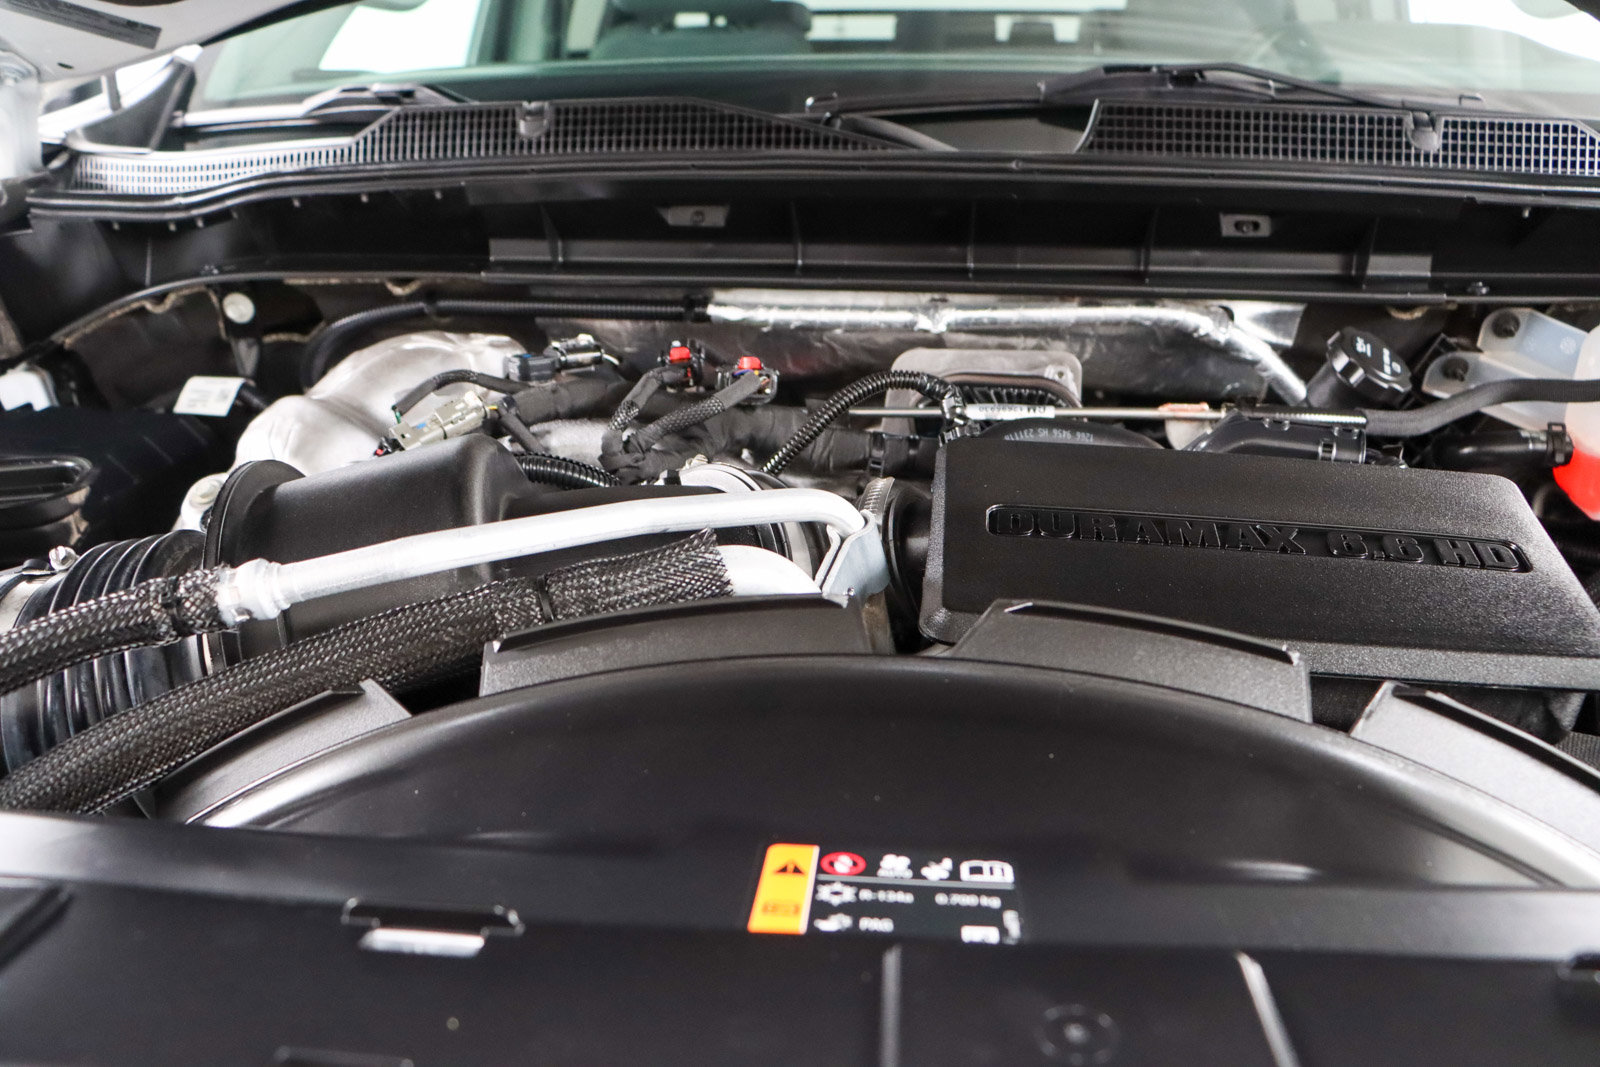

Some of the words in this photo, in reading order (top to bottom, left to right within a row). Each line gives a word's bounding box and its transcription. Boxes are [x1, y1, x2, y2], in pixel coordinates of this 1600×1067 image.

[996, 508, 1306, 556] DURAMAX
[1326, 531, 1425, 563] 6.6
[1433, 537, 1520, 570] HD
